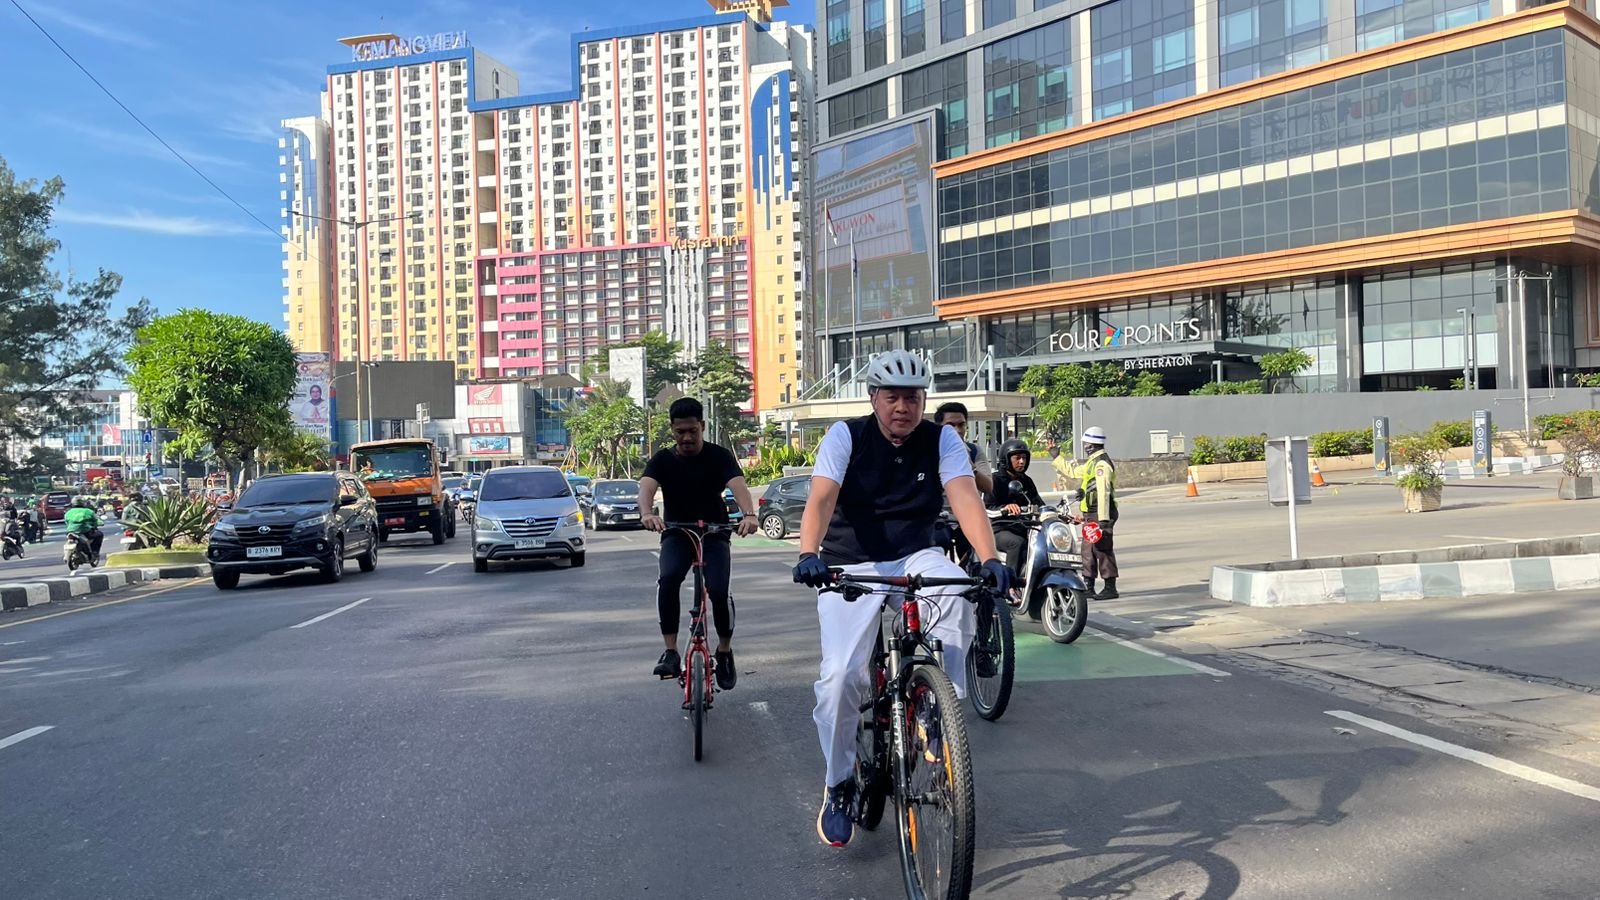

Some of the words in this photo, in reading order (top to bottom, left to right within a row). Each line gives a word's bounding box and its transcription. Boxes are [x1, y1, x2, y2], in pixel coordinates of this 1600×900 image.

[1050, 329, 1101, 352] FOUR
[1124, 318, 1201, 345] POINTS
[1124, 359, 1137, 370] BY
[1138, 356, 1193, 369] SHERATON
